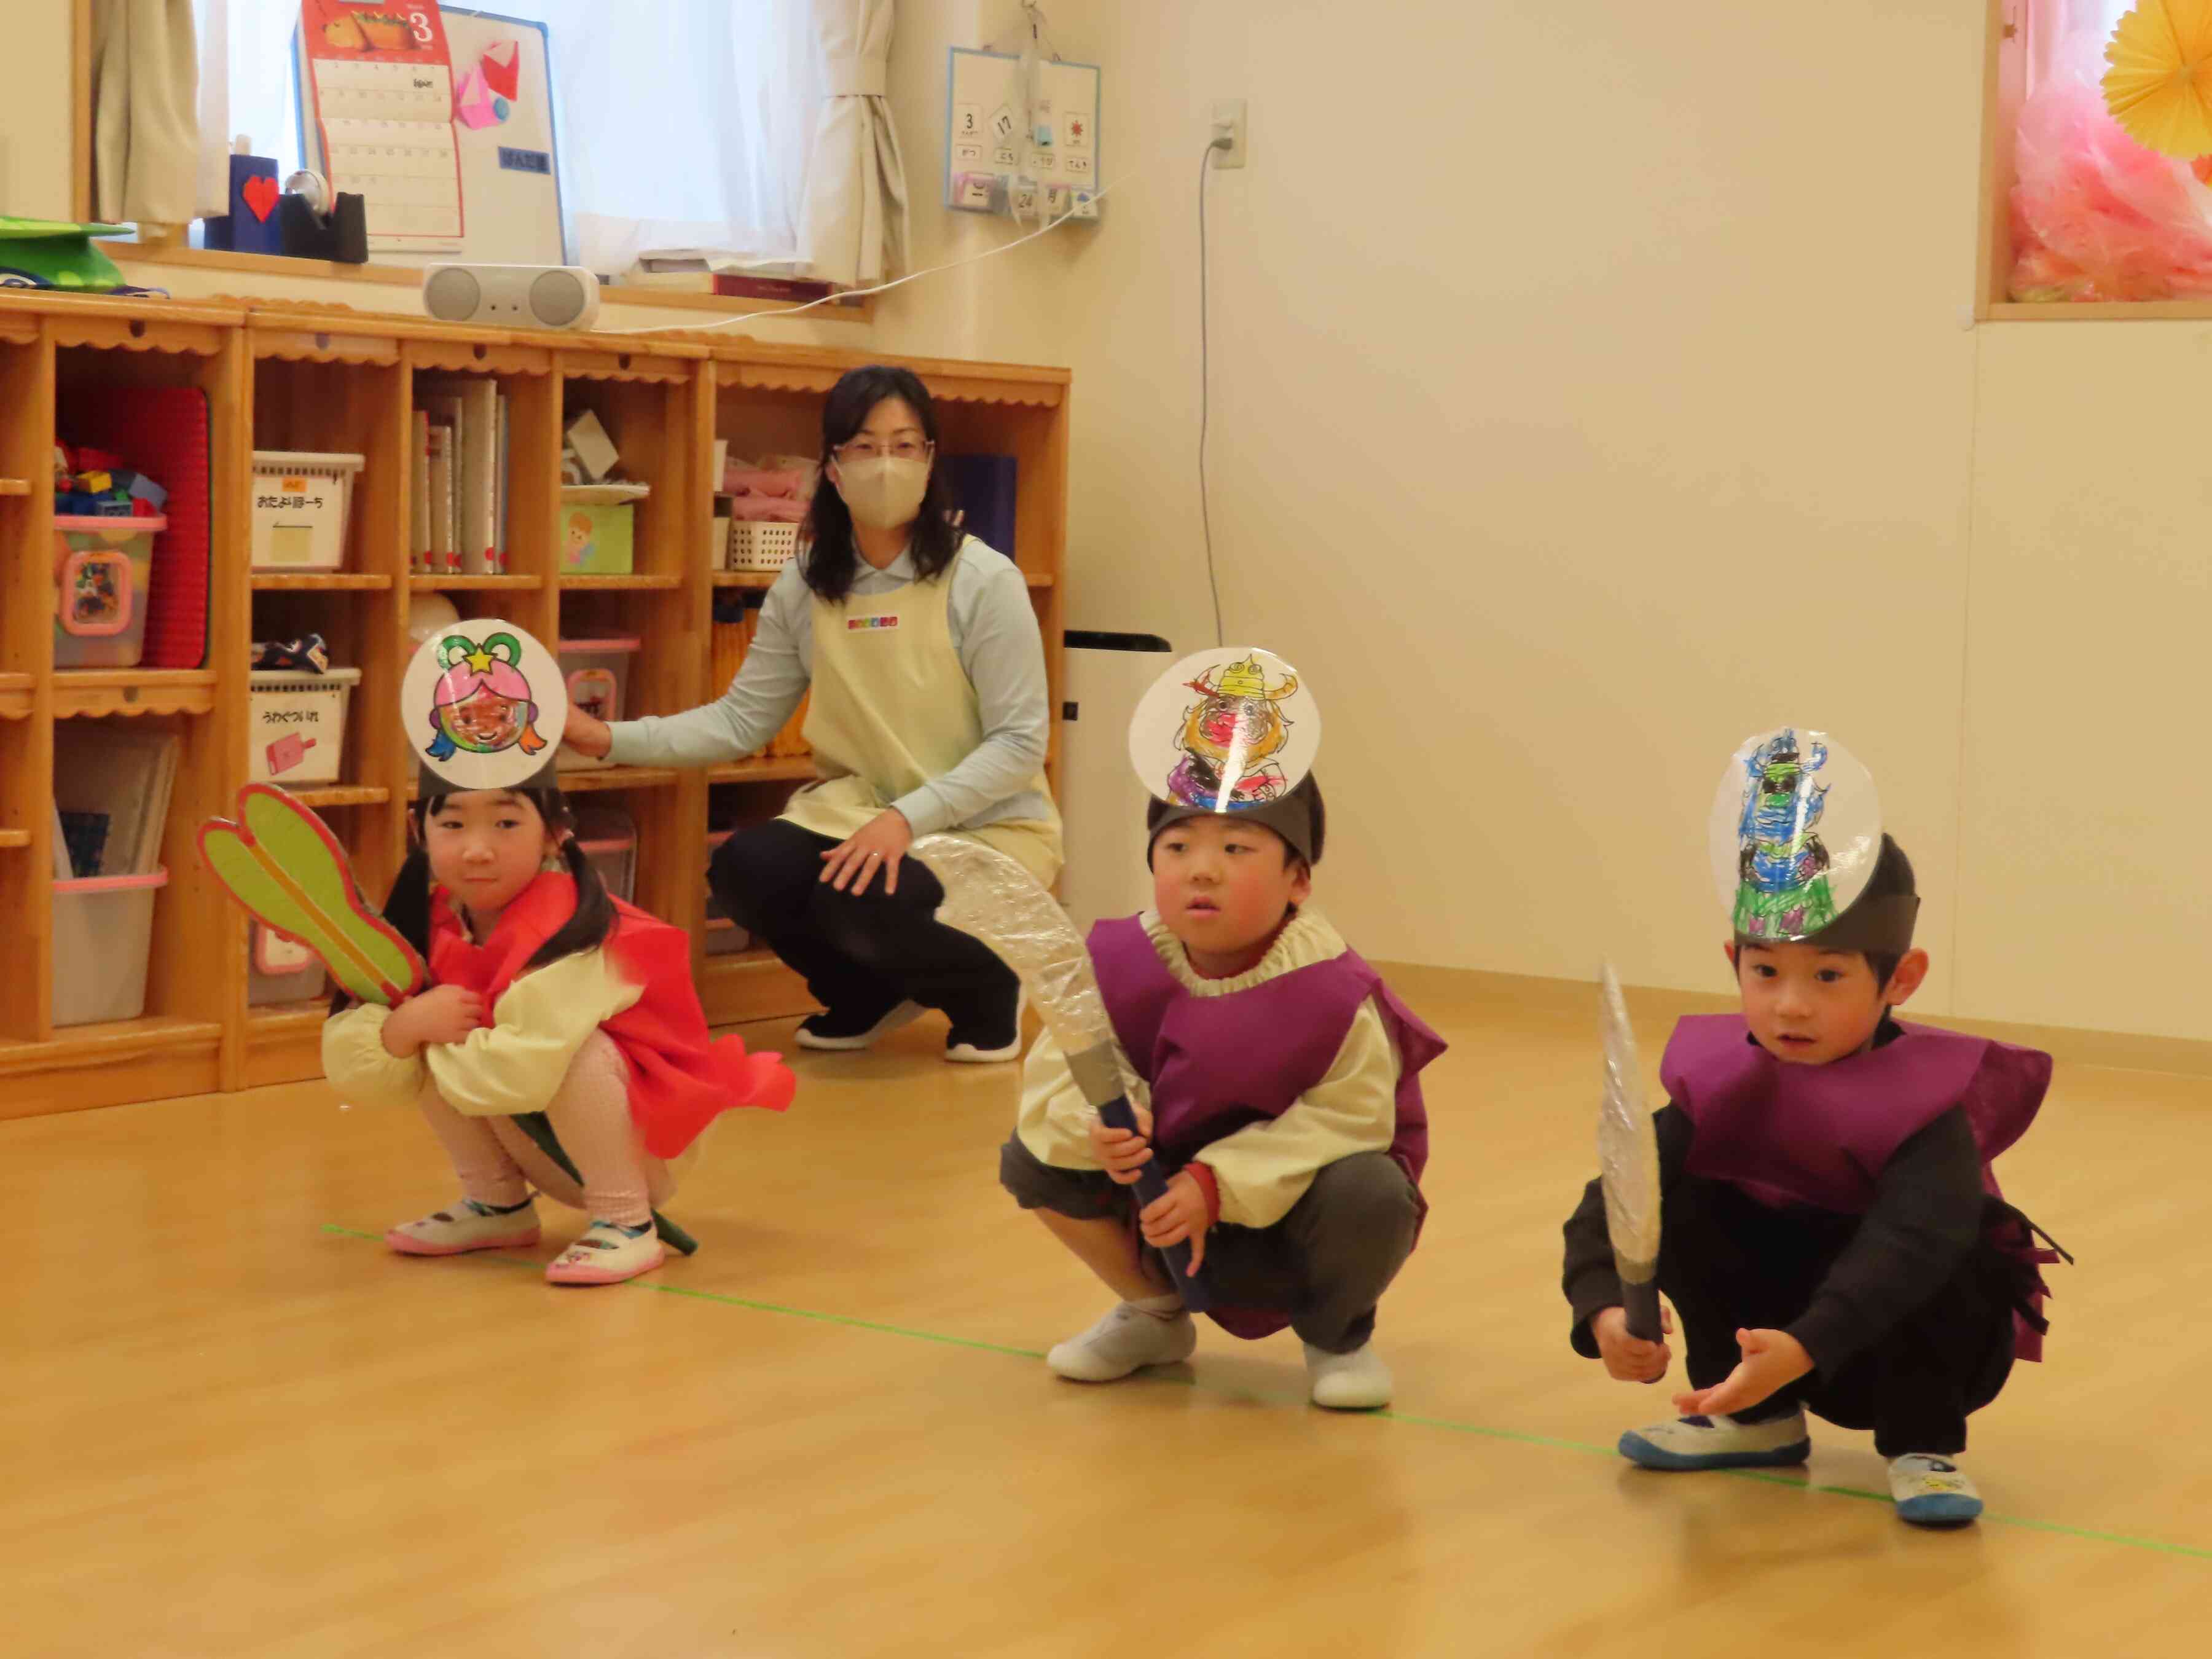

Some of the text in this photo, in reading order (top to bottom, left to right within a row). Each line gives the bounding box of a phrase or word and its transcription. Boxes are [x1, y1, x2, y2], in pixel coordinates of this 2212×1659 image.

[410, 12, 433, 42] 3
[965, 112, 974, 129] 3
[997, 115, 1012, 135] 17
